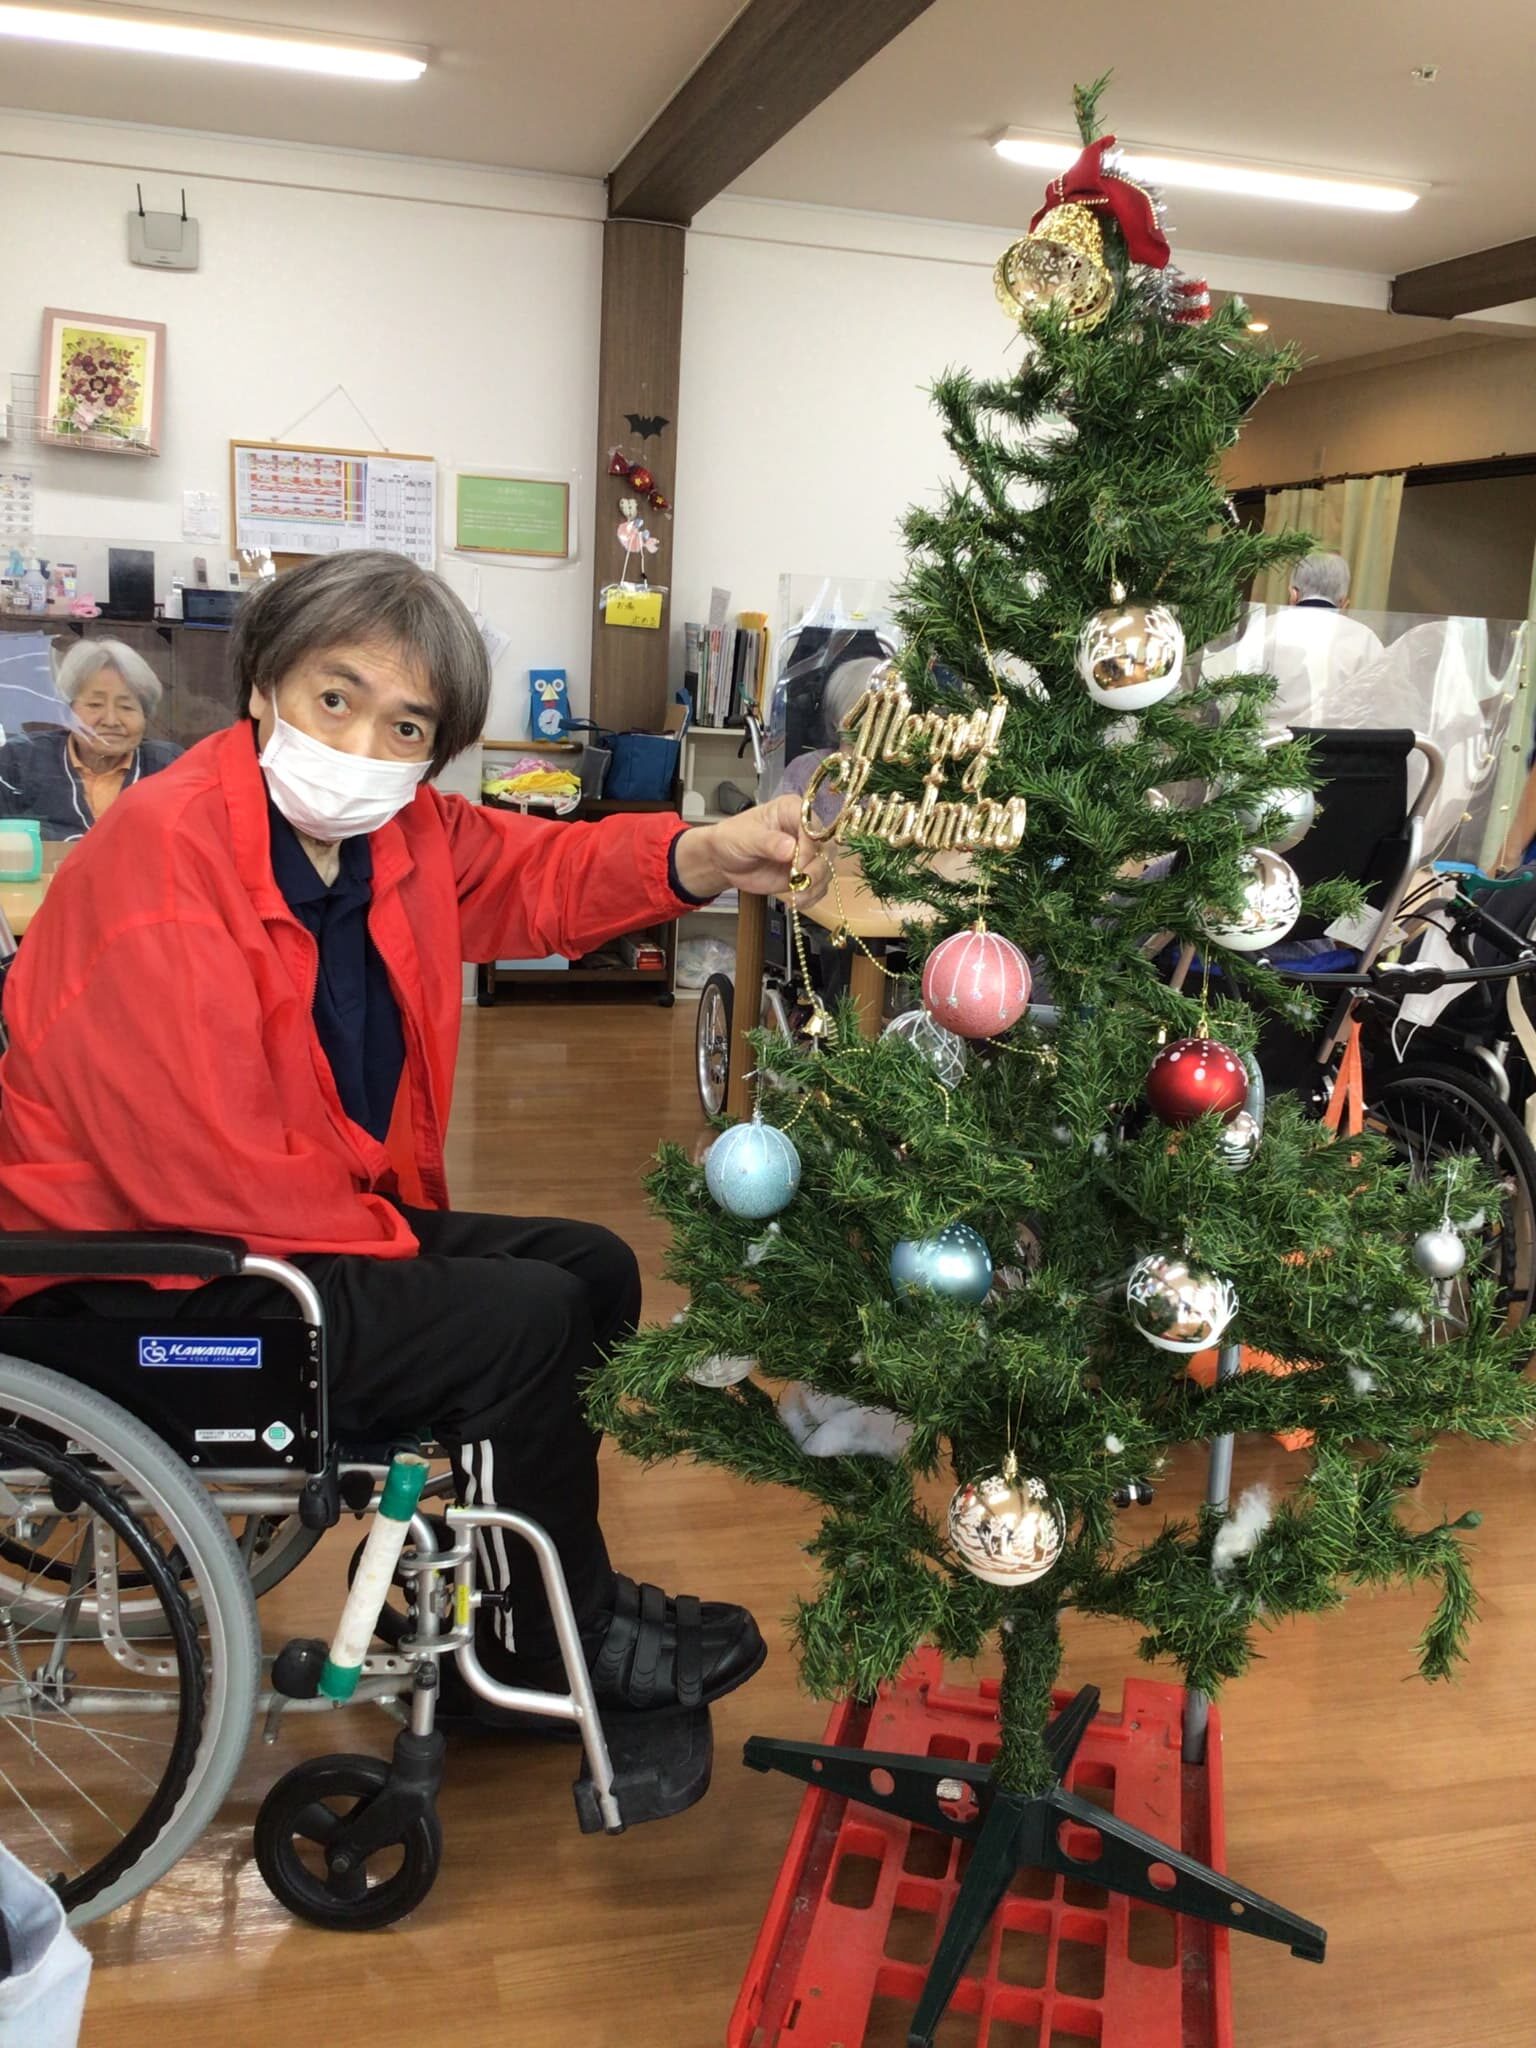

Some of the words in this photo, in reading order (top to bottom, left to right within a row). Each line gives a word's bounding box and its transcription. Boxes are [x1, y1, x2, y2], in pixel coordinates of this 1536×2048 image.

[841, 688, 1010, 793] Merry
[801, 751, 1027, 852] Christmas
[169, 1344, 257, 1357] KAWAMURA
